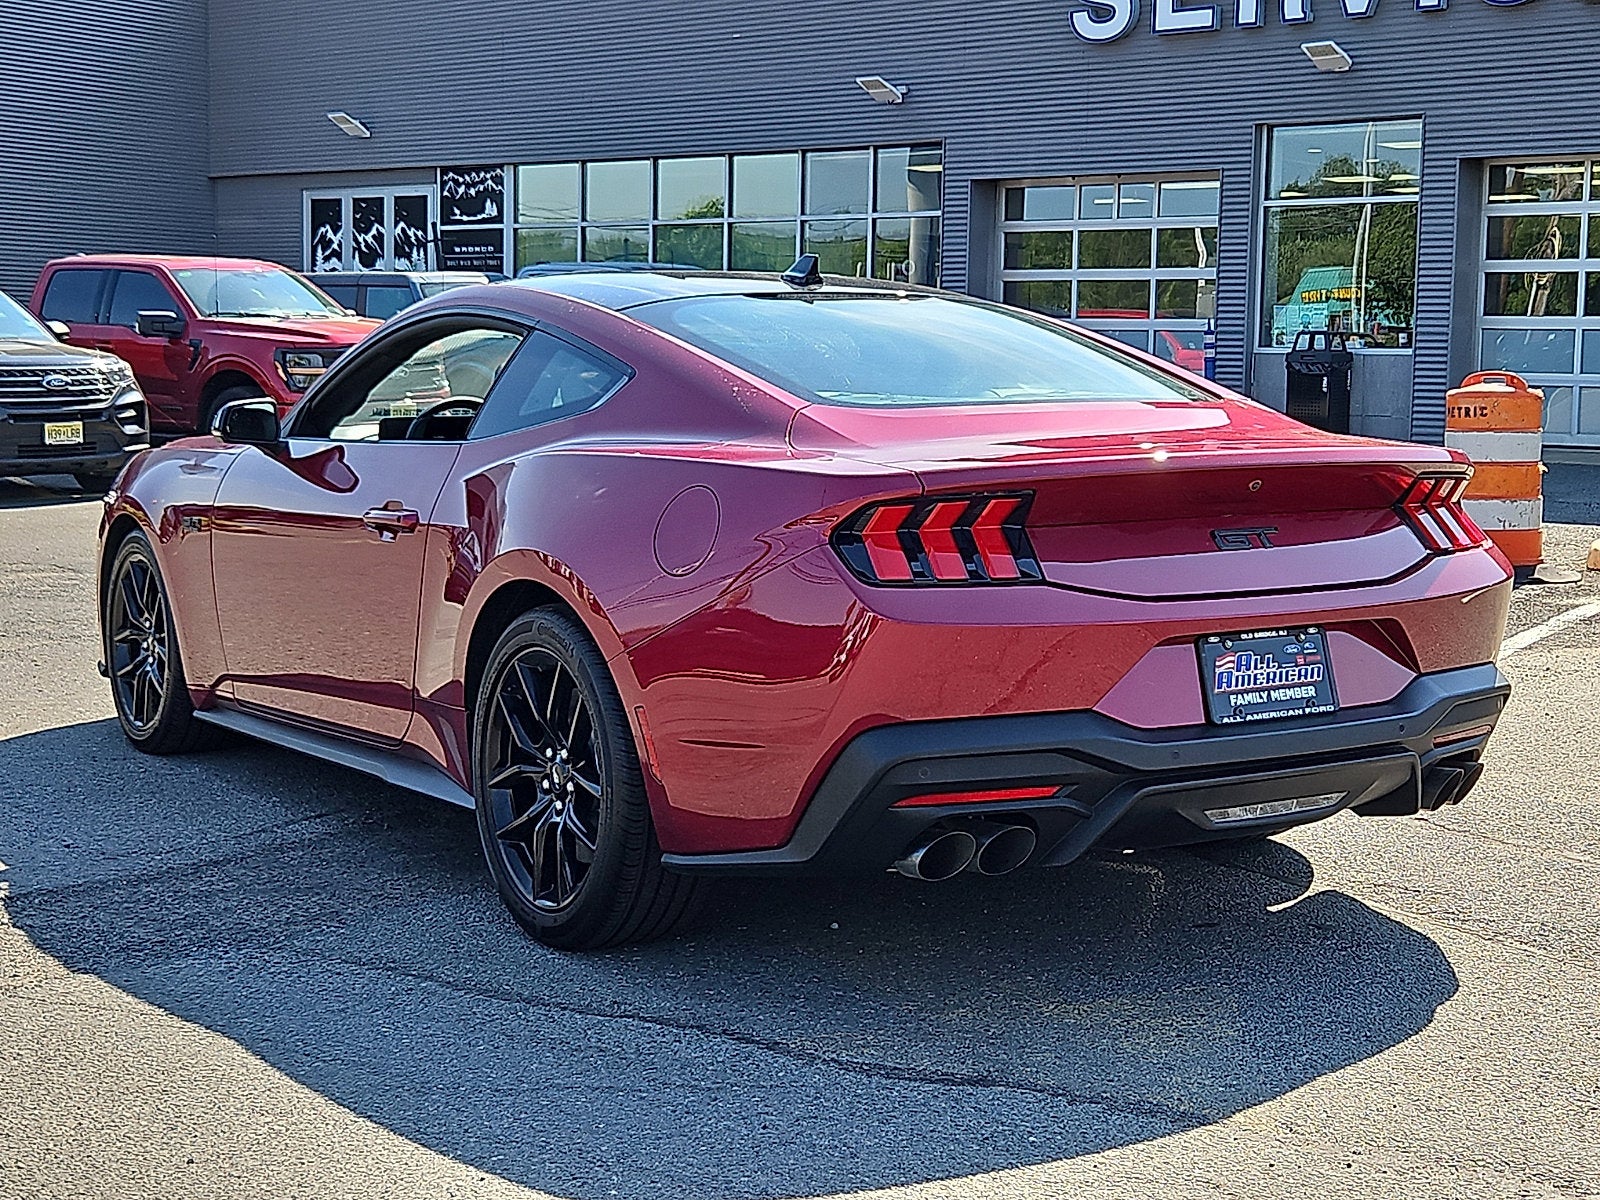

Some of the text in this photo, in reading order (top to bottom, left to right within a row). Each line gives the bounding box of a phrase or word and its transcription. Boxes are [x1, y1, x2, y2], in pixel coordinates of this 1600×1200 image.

[453, 245, 495, 253] BRONCO
[1447, 405, 1488, 418] ETRIC
[1209, 526, 1279, 551] GT
[1235, 651, 1278, 673] ALL
[1215, 664, 1324, 693] AMERICAN
[1230, 685, 1316, 707] FAMILY MEMBER
[1222, 705, 1335, 724] ALL AMERICAN FORD
